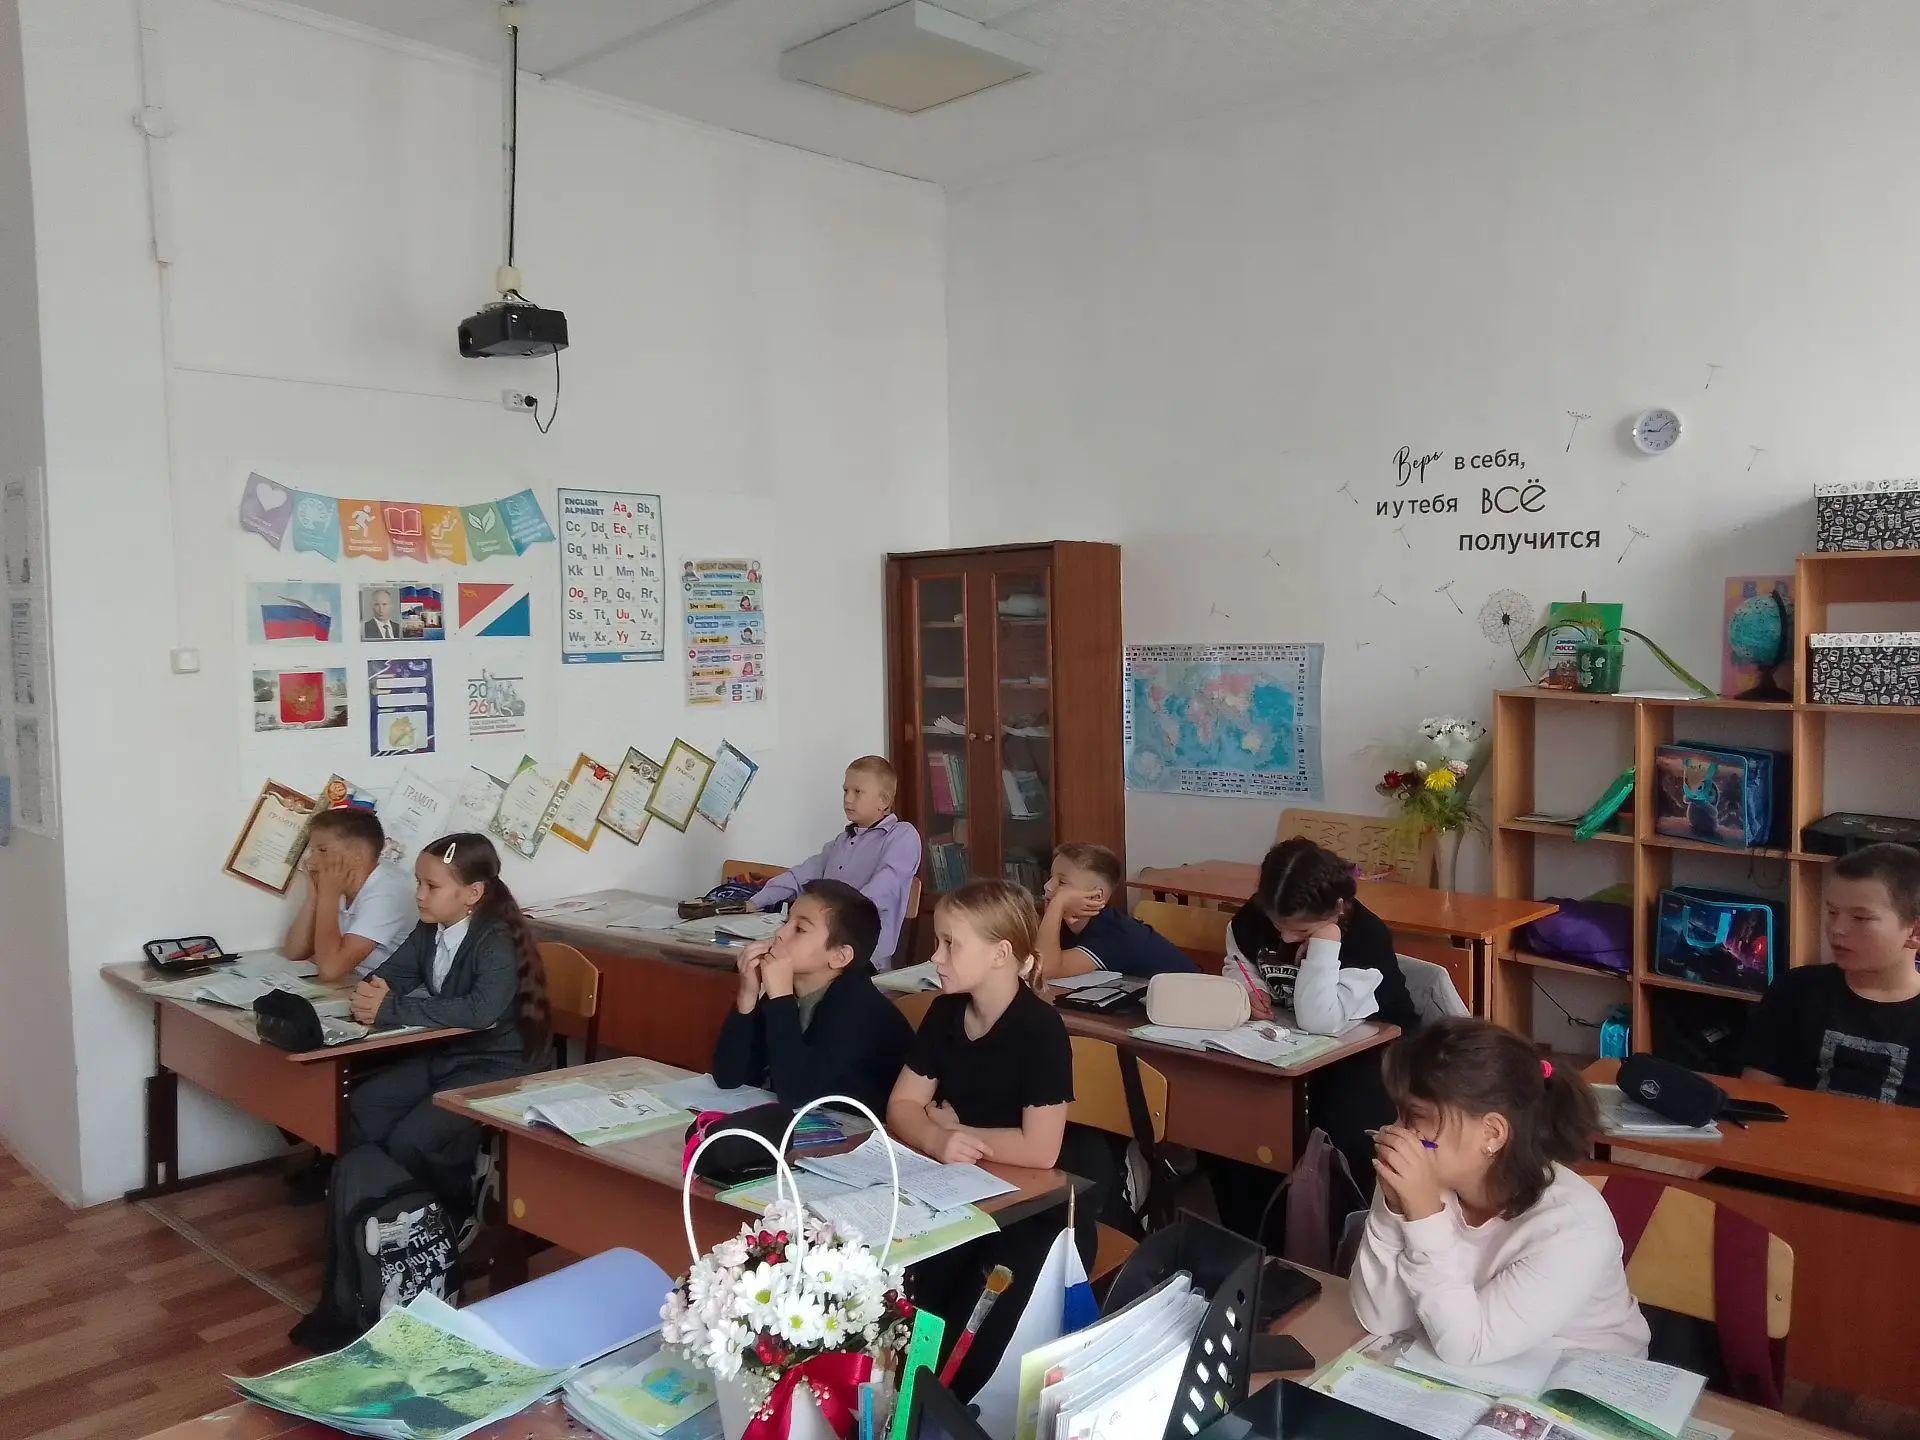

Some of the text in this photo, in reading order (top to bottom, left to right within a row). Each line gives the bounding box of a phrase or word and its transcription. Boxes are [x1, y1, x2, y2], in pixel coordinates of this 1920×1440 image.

[1393, 446, 1526, 487] Верь в себя,
[564, 497, 598, 507] ENGLISH
[613, 501, 650, 514] Aa Bb
[1376, 500, 1388, 516] и
[1392, 500, 1405, 518] у
[1408, 494, 1458, 515] тебя
[564, 506, 605, 516] ALPHABET
[566, 520, 649, 536] Cc Dd Ee Ff
[567, 542, 583, 557] Gg
[592, 543, 608, 555] Hh
[1459, 530, 1601, 555] получится
[567, 564, 584, 577] Kk
[616, 565, 635, 577] Mm
[640, 566, 655, 577] Nn
[568, 587, 653, 600] Oo Pp Qq Rr
[568, 608, 653, 620] Ss Tt Uu Vv
[594, 631, 607, 642] Xx
[616, 630, 629, 643] Yy
[640, 630, 652, 641] Zz
[468, 682, 489, 699] 20
[469, 699, 489, 715] 26
